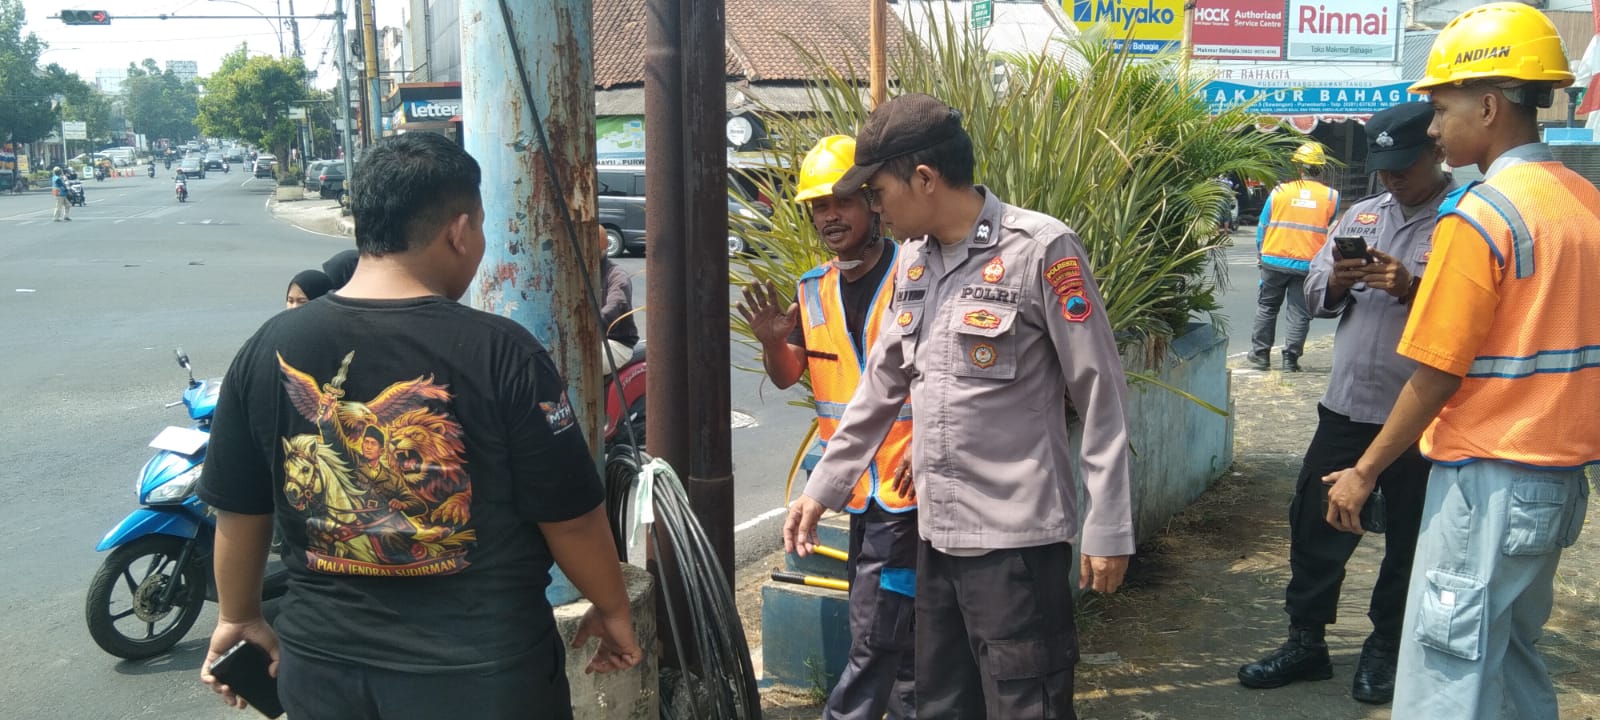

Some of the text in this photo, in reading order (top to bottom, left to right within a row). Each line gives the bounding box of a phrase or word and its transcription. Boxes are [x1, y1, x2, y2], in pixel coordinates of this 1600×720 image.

[1095, 0, 1174, 30] Miyako
[1194, 8, 1230, 21] HOCK
[1234, 10, 1282, 20] Authorized
[1298, 4, 1388, 35] Rinnai
[1259, 20, 1282, 28] Centre
[1454, 46, 1511, 65] ANDIAN
[1241, 69, 1290, 80] BAHAGIA
[1320, 89, 1430, 103] BAHAGIA
[411, 102, 458, 118] letter
[1346, 226, 1377, 236] INDRA
[961, 287, 1019, 304] POLRI
[317, 558, 345, 573] PIALA
[395, 558, 458, 576] SUDIRMAN
